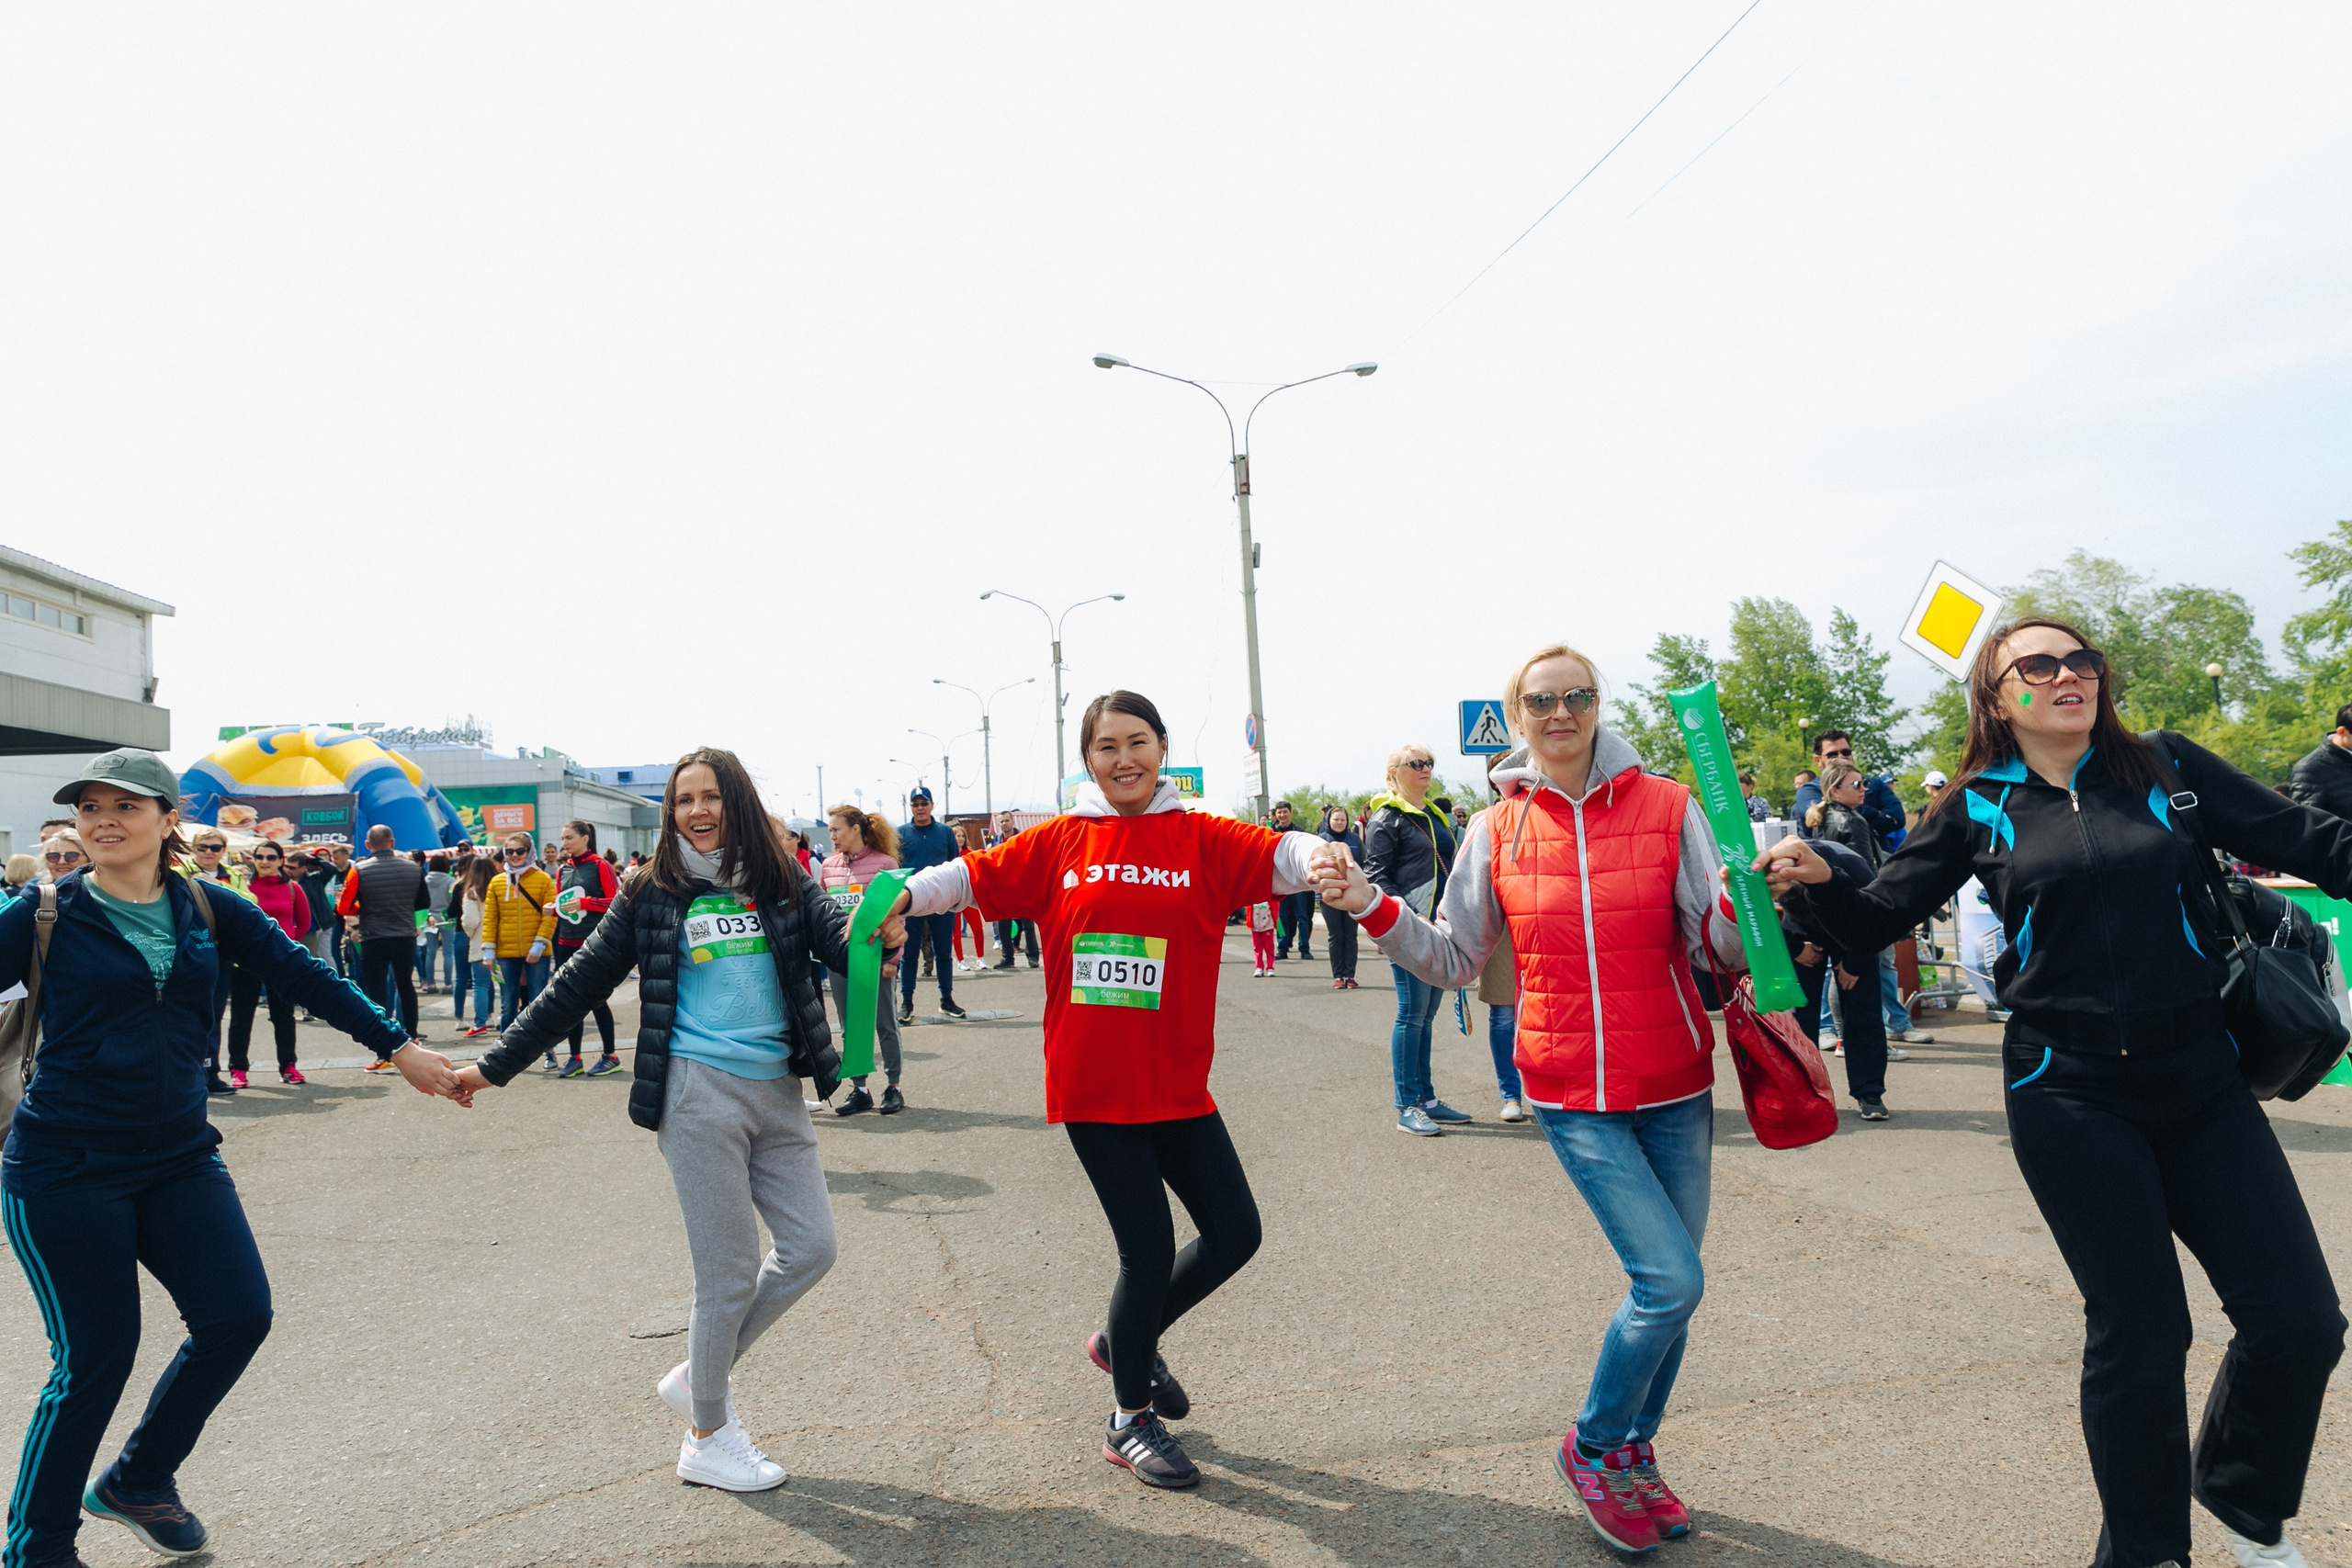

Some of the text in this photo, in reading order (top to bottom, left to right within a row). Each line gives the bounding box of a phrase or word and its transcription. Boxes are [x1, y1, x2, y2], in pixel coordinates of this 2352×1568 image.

[1693, 732, 1729, 815] СБЕРБАНК
[301, 832, 348, 843] ЗДЕСЬ
[1085, 863, 1191, 888] этажи
[835, 895, 860, 906] 0320
[1747, 911, 1764, 947] МАРАФОН
[726, 941, 753, 950] бежим
[734, 976, 756, 989] EST
[1098, 960, 1157, 987] 0510
[1101, 988, 1129, 1000] бежим
[708, 990, 776, 1022] Belle
